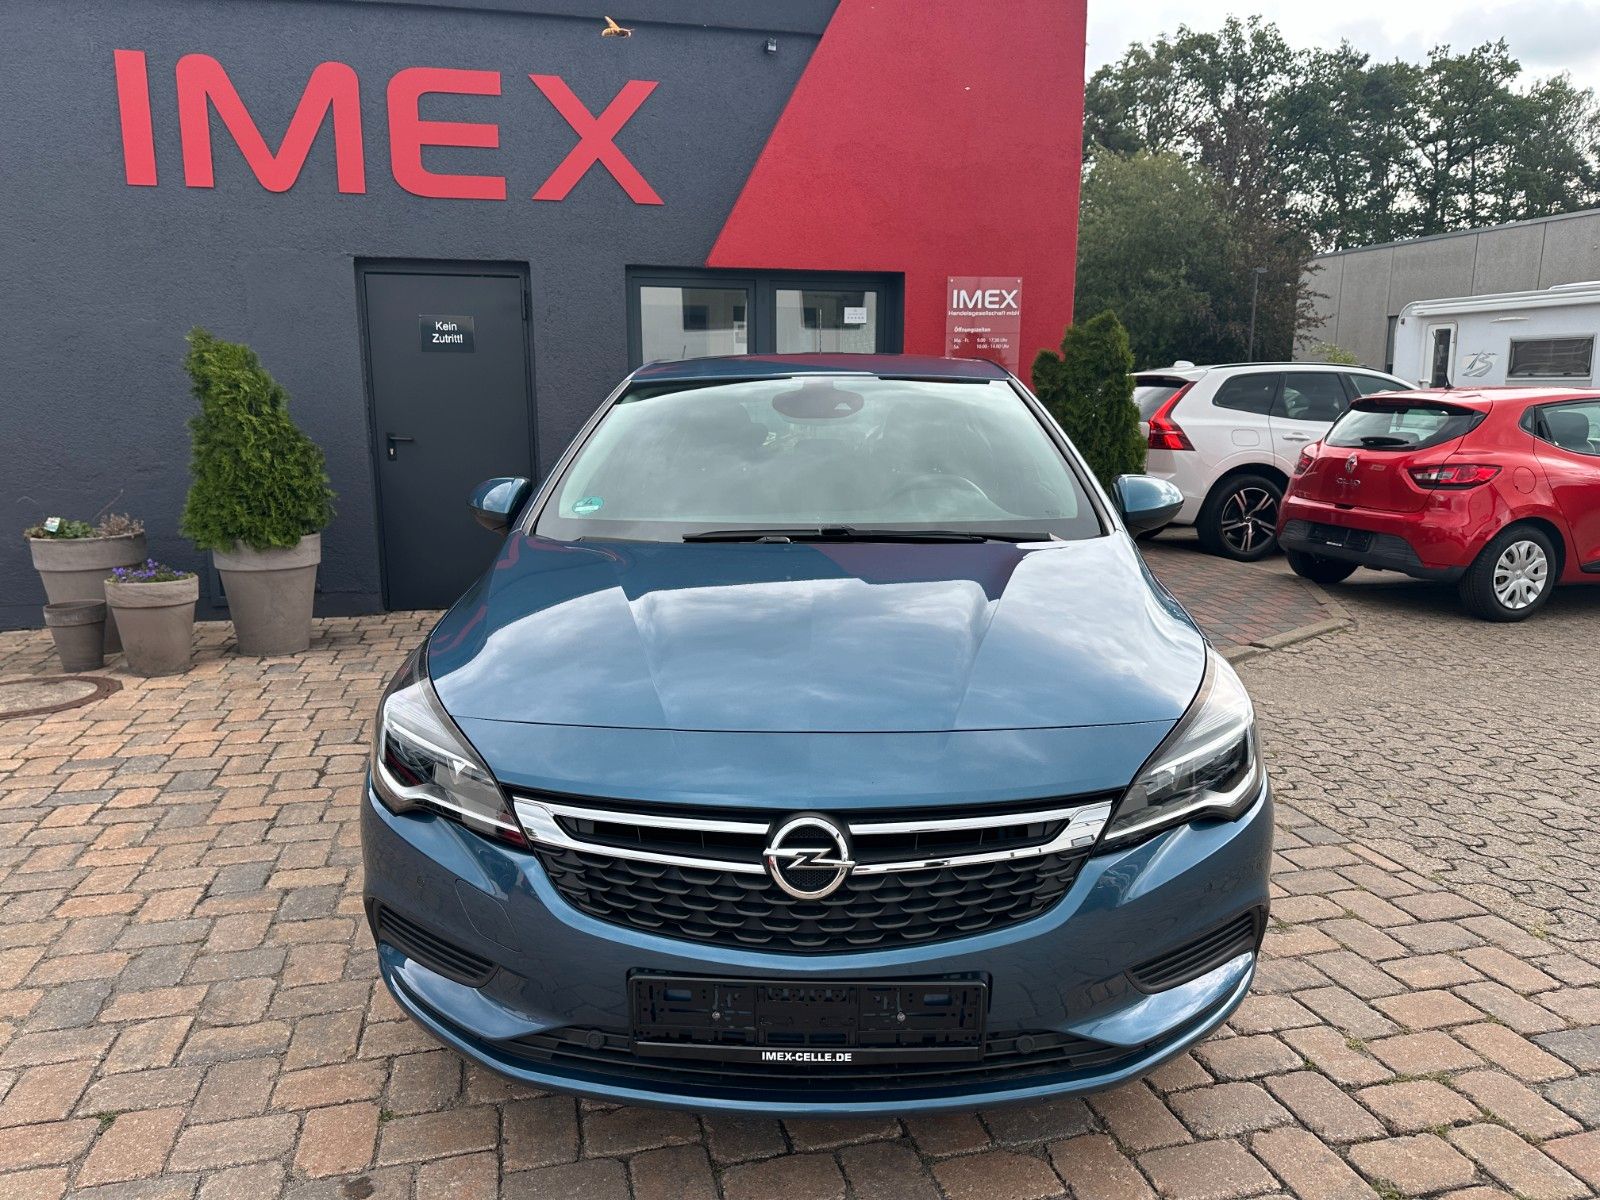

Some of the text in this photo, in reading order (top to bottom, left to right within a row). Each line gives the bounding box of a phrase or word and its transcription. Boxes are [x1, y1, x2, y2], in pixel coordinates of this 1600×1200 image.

[114, 49, 664, 205] IMEX
[953, 289, 1018, 309] IMEX
[435, 321, 457, 331] Kein
[432, 333, 463, 343] Zutritt!
[761, 1051, 852, 1062] IMEX-CELLE.DE
